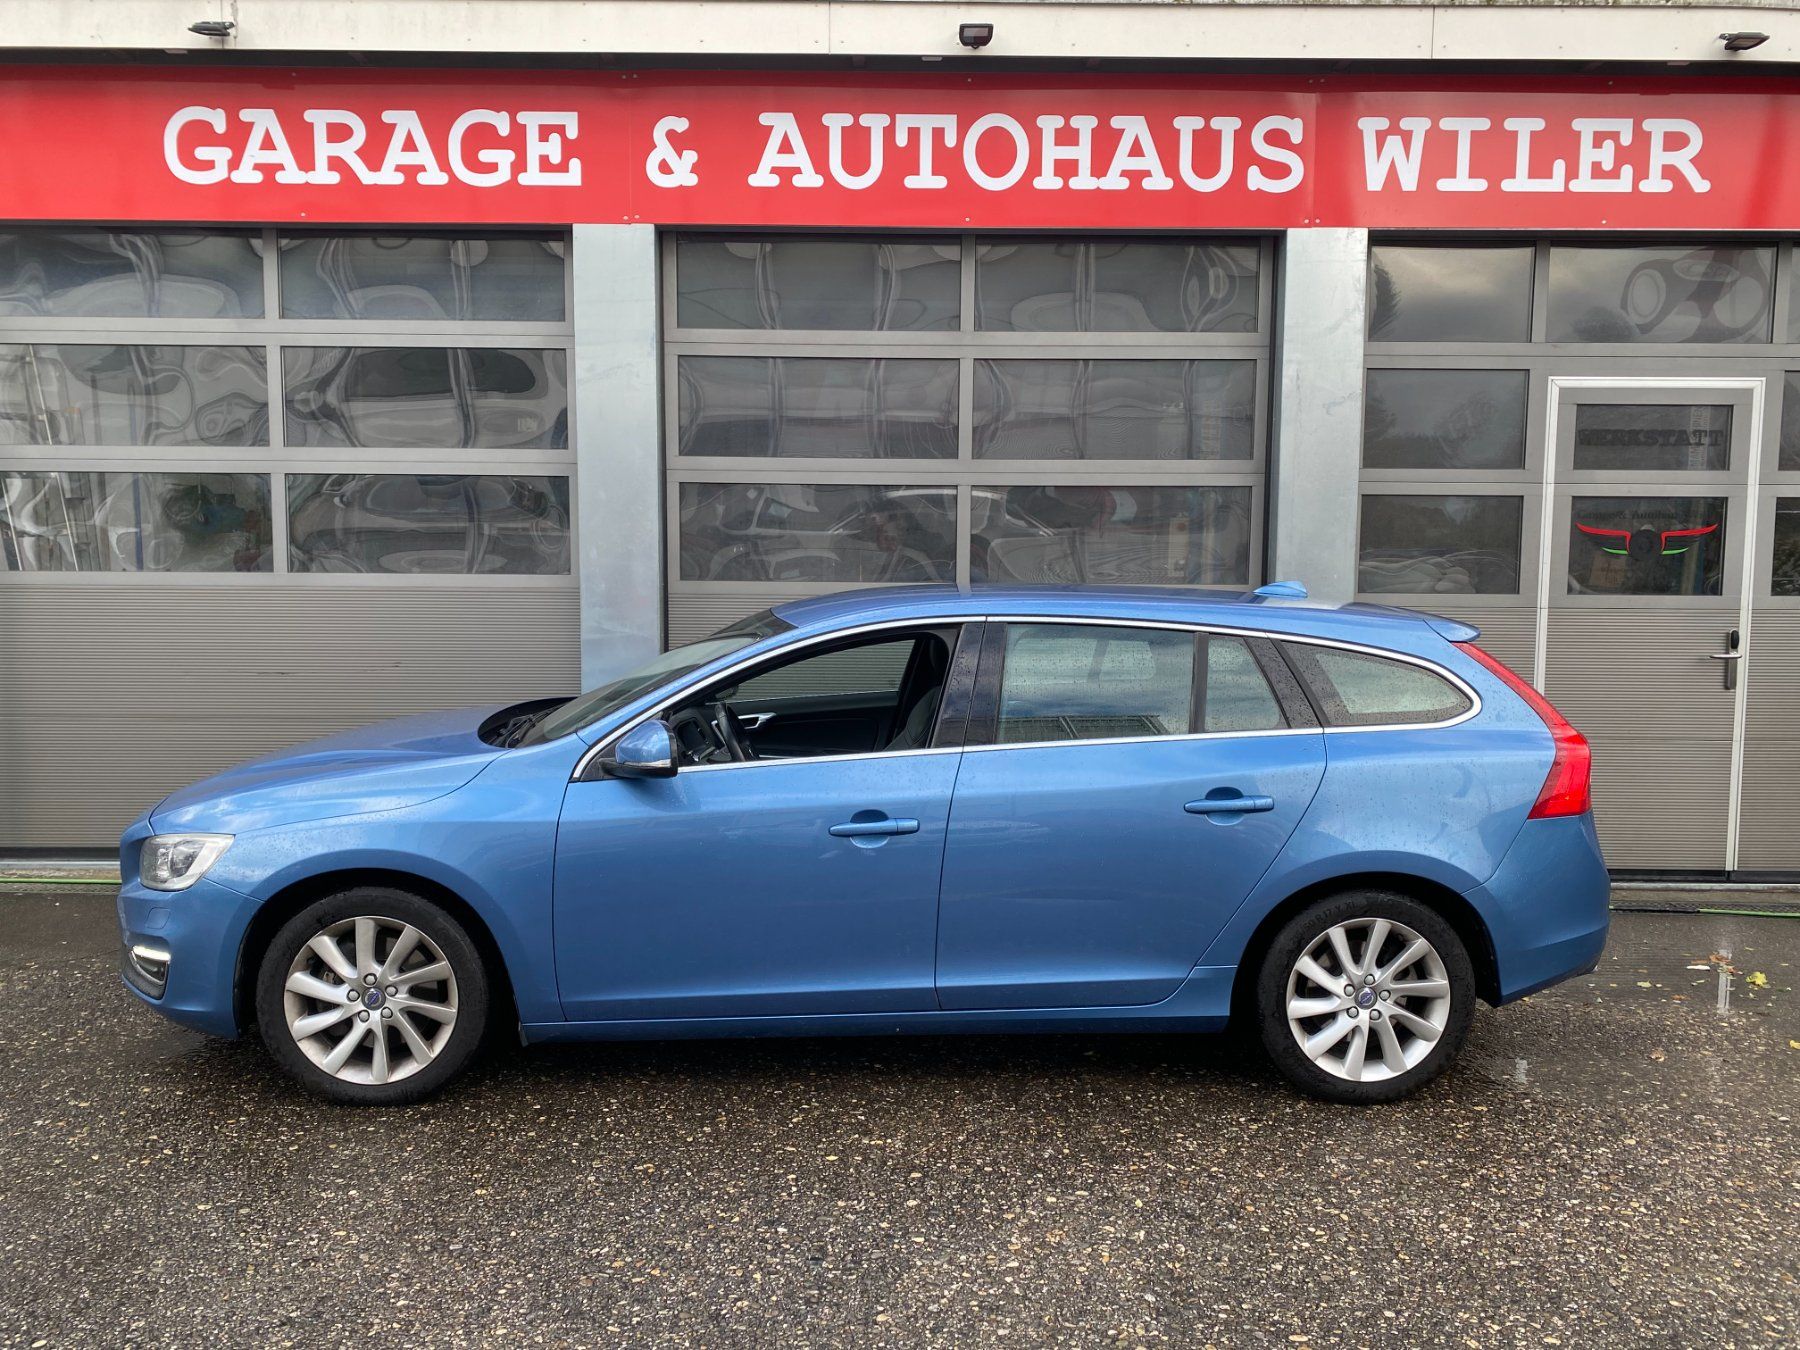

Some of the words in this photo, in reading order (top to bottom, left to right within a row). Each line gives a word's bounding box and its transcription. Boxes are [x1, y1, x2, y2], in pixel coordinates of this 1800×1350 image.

[164, 106, 581, 187] GARAGE
[646, 116, 698, 188] &
[748, 112, 1304, 193] AUTOHAUS
[1358, 117, 1711, 193] WILER
[1577, 429, 1724, 447] WERKSTATT
